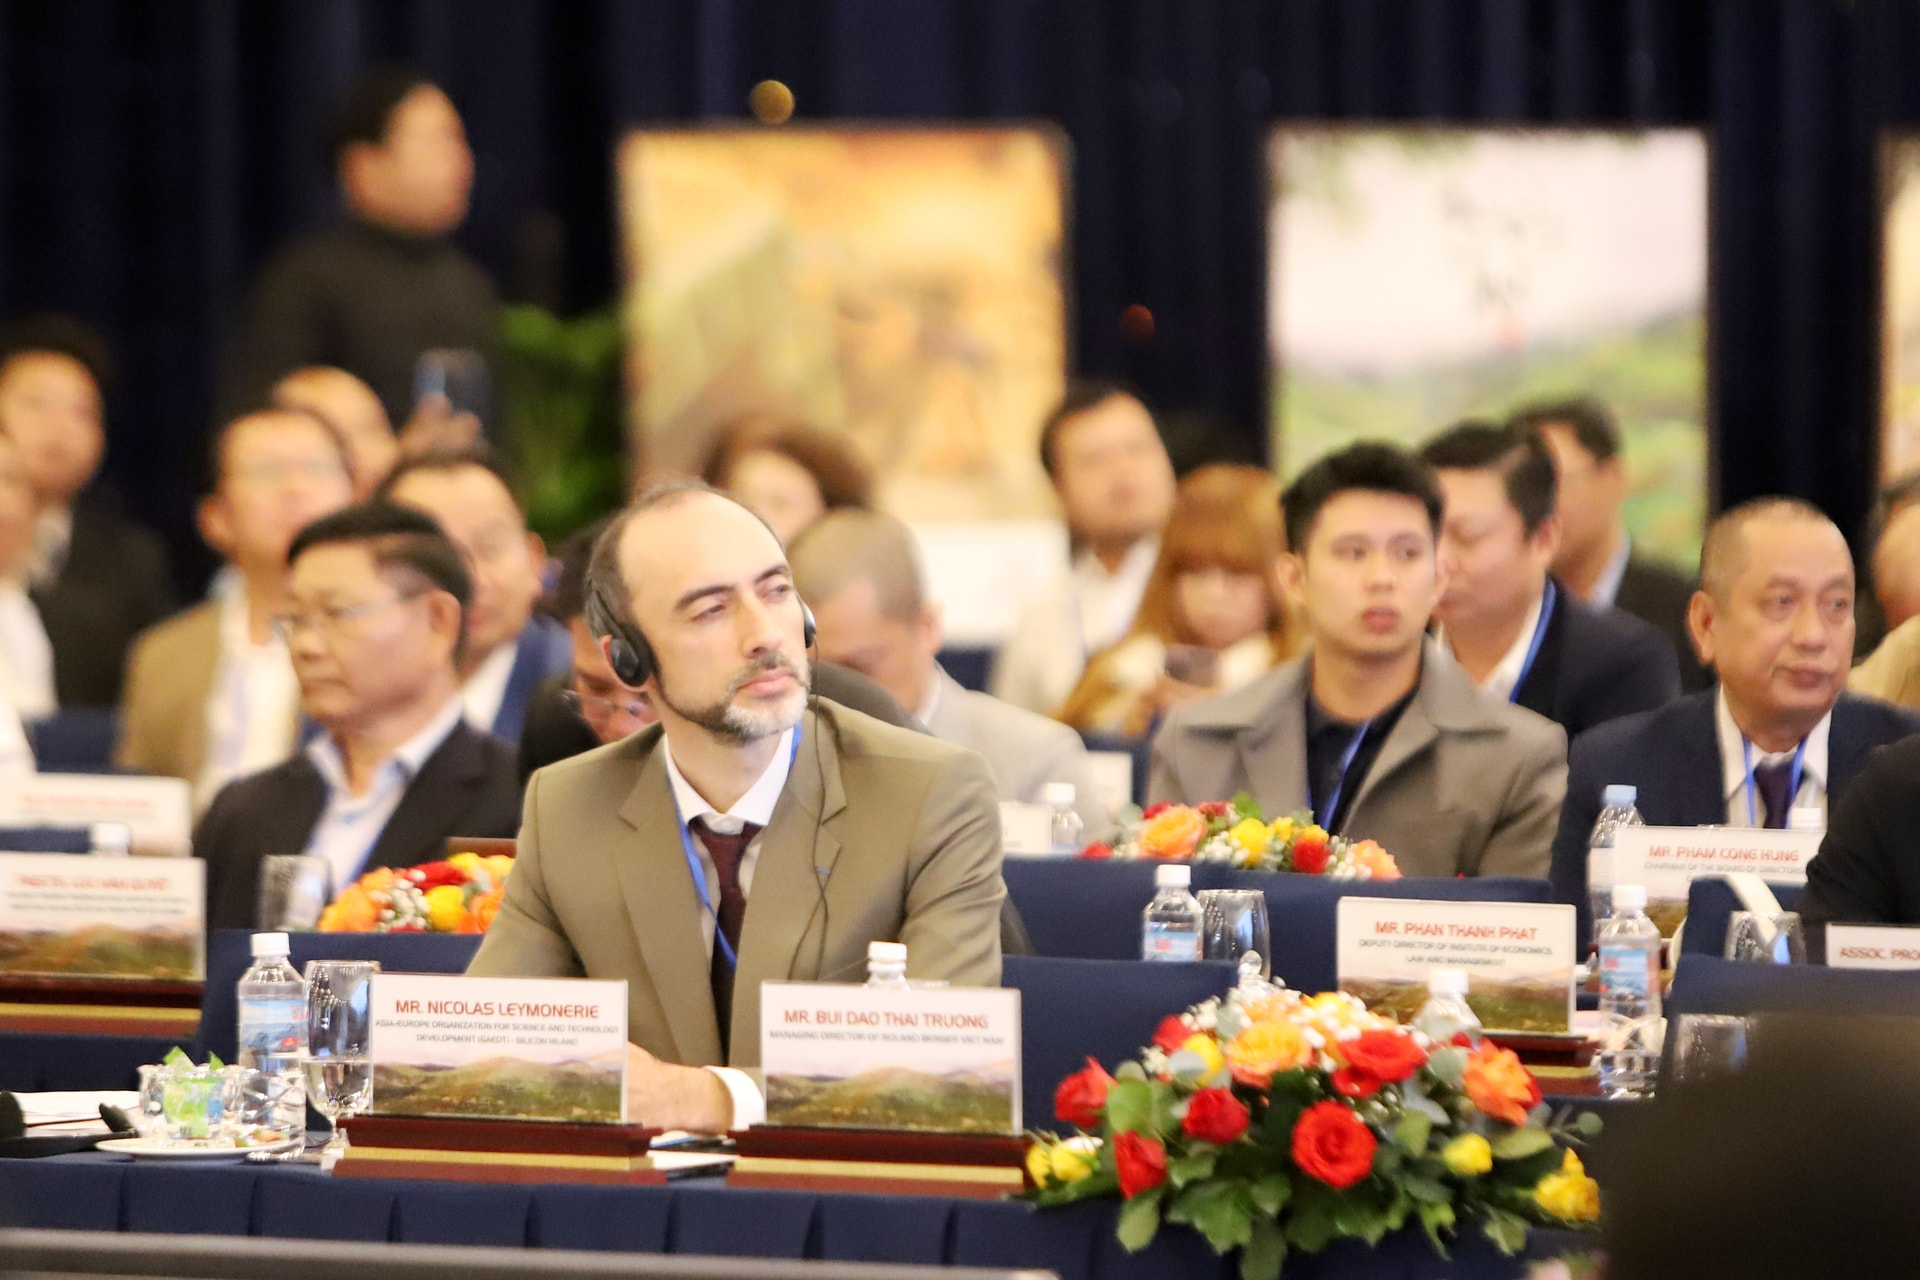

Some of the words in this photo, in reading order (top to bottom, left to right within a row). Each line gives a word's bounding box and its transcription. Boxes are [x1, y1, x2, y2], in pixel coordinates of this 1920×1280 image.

[1677, 847, 1717, 859] PHAM
[1720, 847, 1757, 860] CONG
[1760, 849, 1799, 861] HUNG
[1405, 922, 1444, 936] PHAN
[1448, 924, 1496, 938] THANH
[1500, 926, 1538, 940] PHAT
[1359, 939, 1392, 948] DEPUTY
[1394, 940, 1433, 949] DIRECTOR
[395, 1000, 424, 1014] MR.
[428, 1001, 494, 1015] NICOLAS
[499, 1002, 599, 1018] LEYMONERIE
[375, 1019, 430, 1028] ASIA-EUROPE
[432, 1020, 492, 1030] ORGANIZATION
[494, 1022, 510, 1030] FOR
[512, 1023, 545, 1032] SCIENCE
[548, 1024, 566, 1032] AND
[567, 1024, 619, 1034] TECHNOLOGY
[816, 1010, 842, 1025] BUI
[847, 1011, 880, 1026] DAO
[884, 1012, 918, 1027] THAI
[923, 1013, 988, 1029] TRUONG
[416, 1033, 476, 1042] DEVELOPMENT
[769, 1030, 818, 1040] MANAGING
[820, 1031, 864, 1041] DIRECTOR
